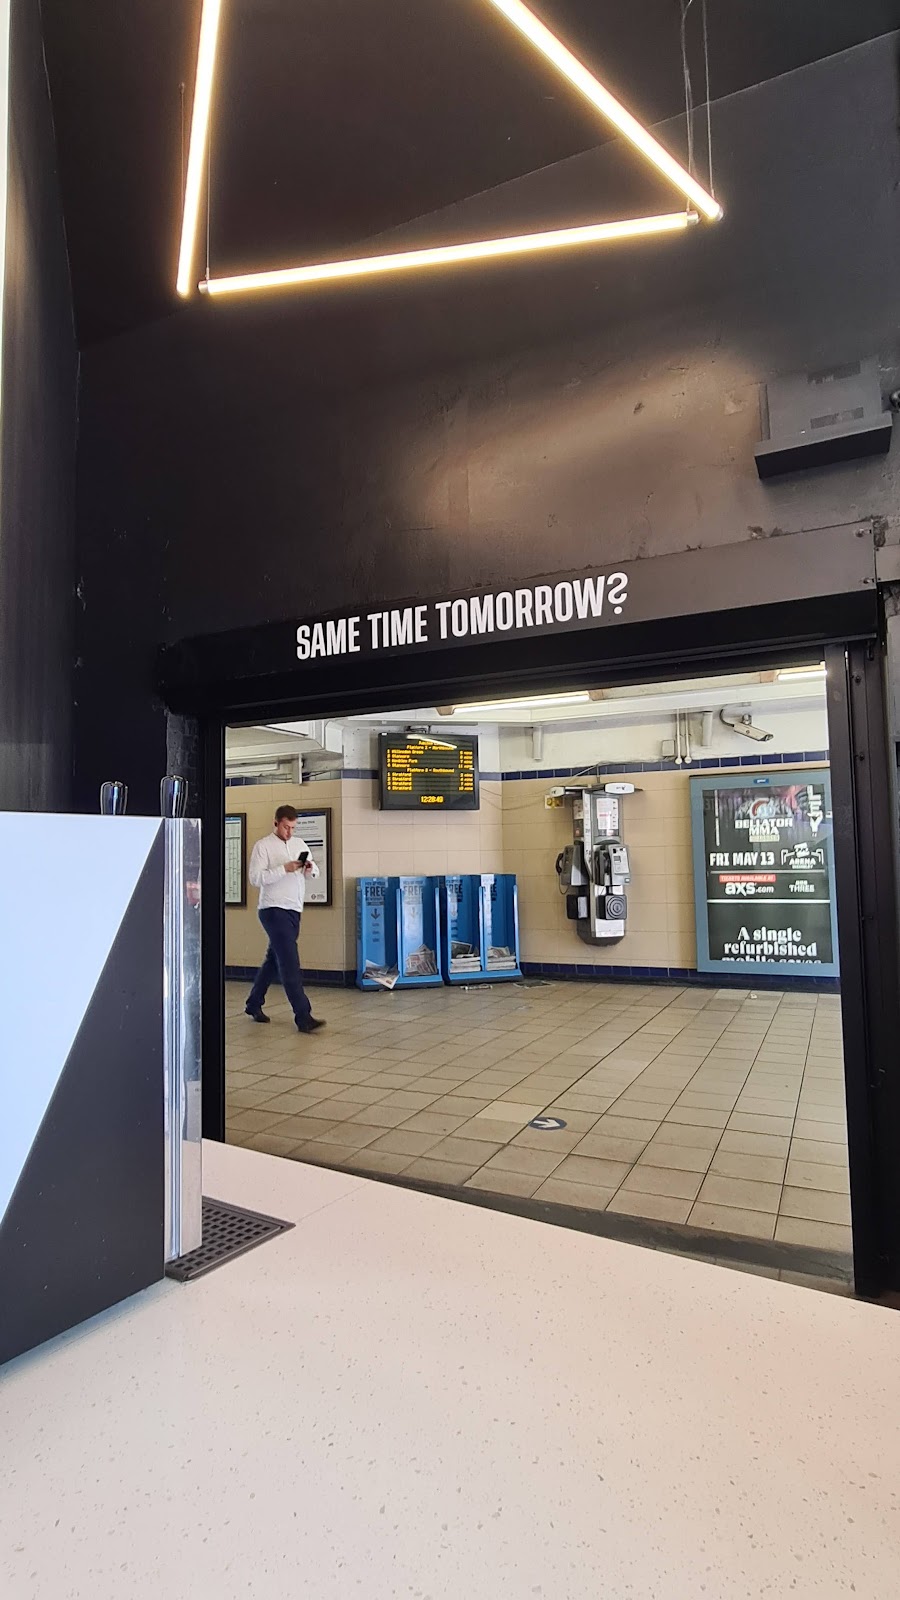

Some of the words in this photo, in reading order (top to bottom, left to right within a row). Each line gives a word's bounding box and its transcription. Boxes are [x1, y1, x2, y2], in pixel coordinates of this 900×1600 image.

[296, 617, 361, 660] SAME
[367, 605, 428, 649] TIME
[435, 572, 628, 640] TOMORROW?
[709, 853, 730, 866] FRI
[732, 852, 759, 866] MAY
[760, 851, 775, 866] 13
[365, 885, 385, 897] FREE
[737, 926, 750, 940] A
[753, 926, 802, 944] single
[724, 941, 817, 956] refurbished
